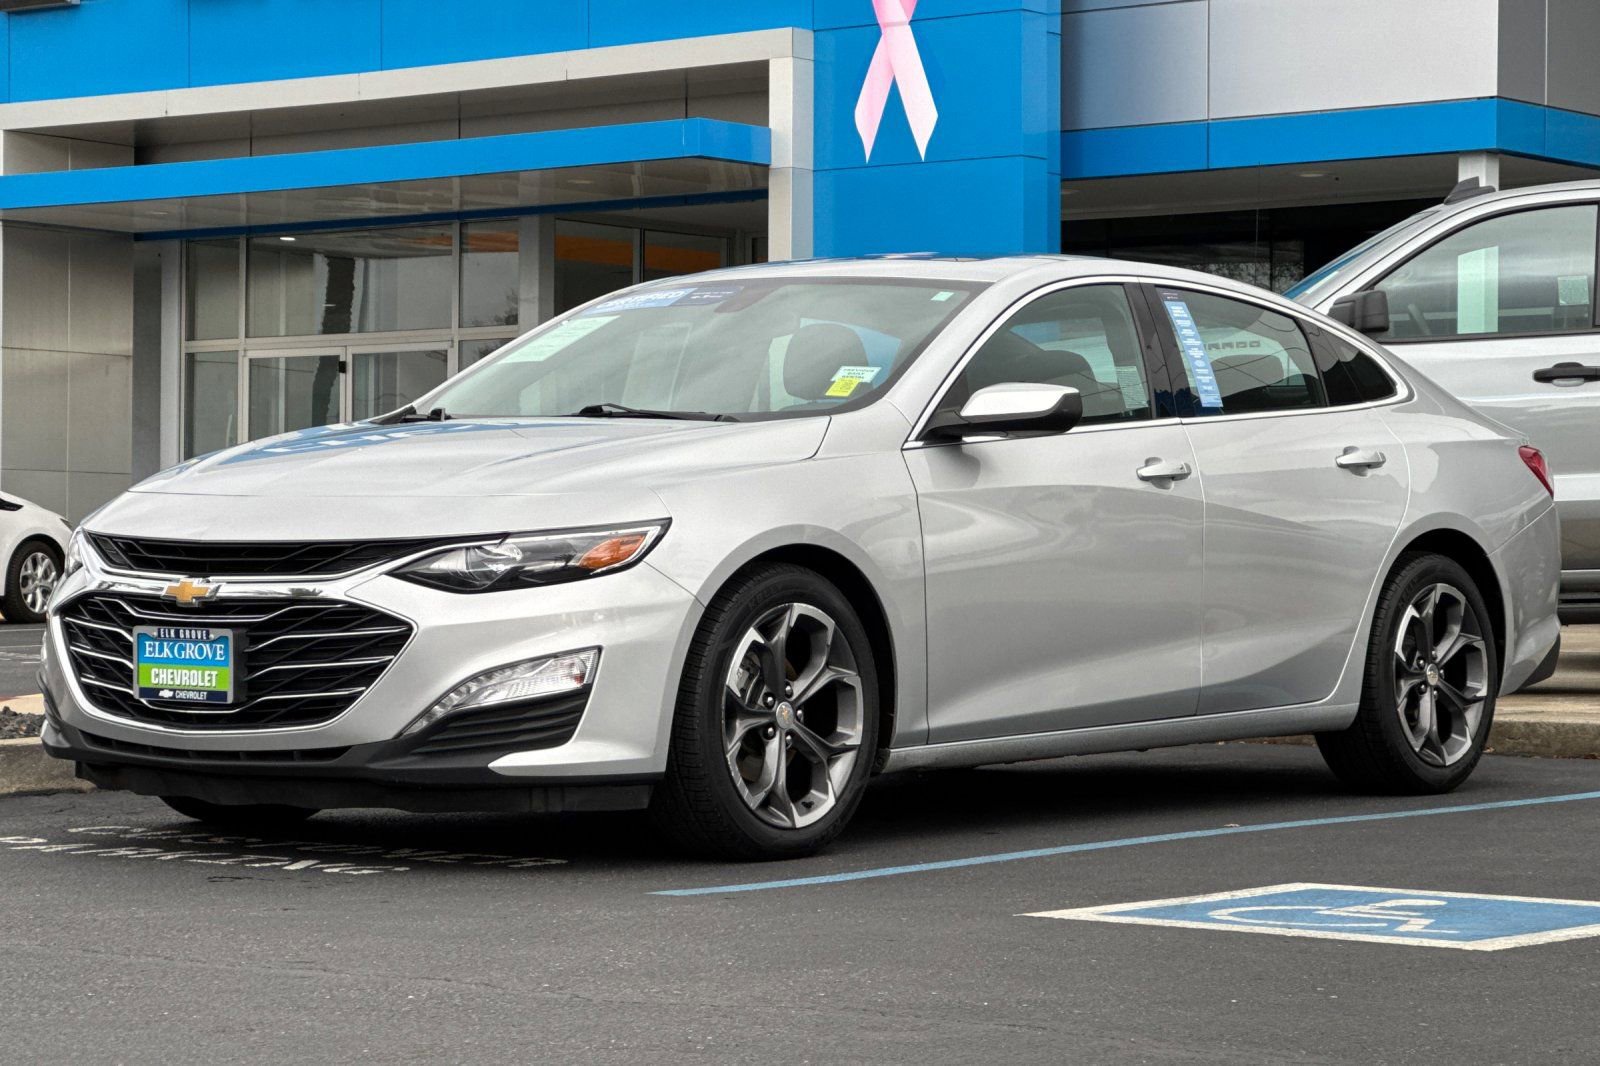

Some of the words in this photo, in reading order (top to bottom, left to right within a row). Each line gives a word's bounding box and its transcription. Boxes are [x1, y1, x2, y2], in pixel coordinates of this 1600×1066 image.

[160, 628, 175, 638] ELK
[180, 629, 207, 640] GROVE
[144, 641, 174, 658] ELK
[174, 642, 225, 660] GROVE
[151, 668, 218, 687] CHEVROLET
[175, 690, 207, 700] CHEVROLET
